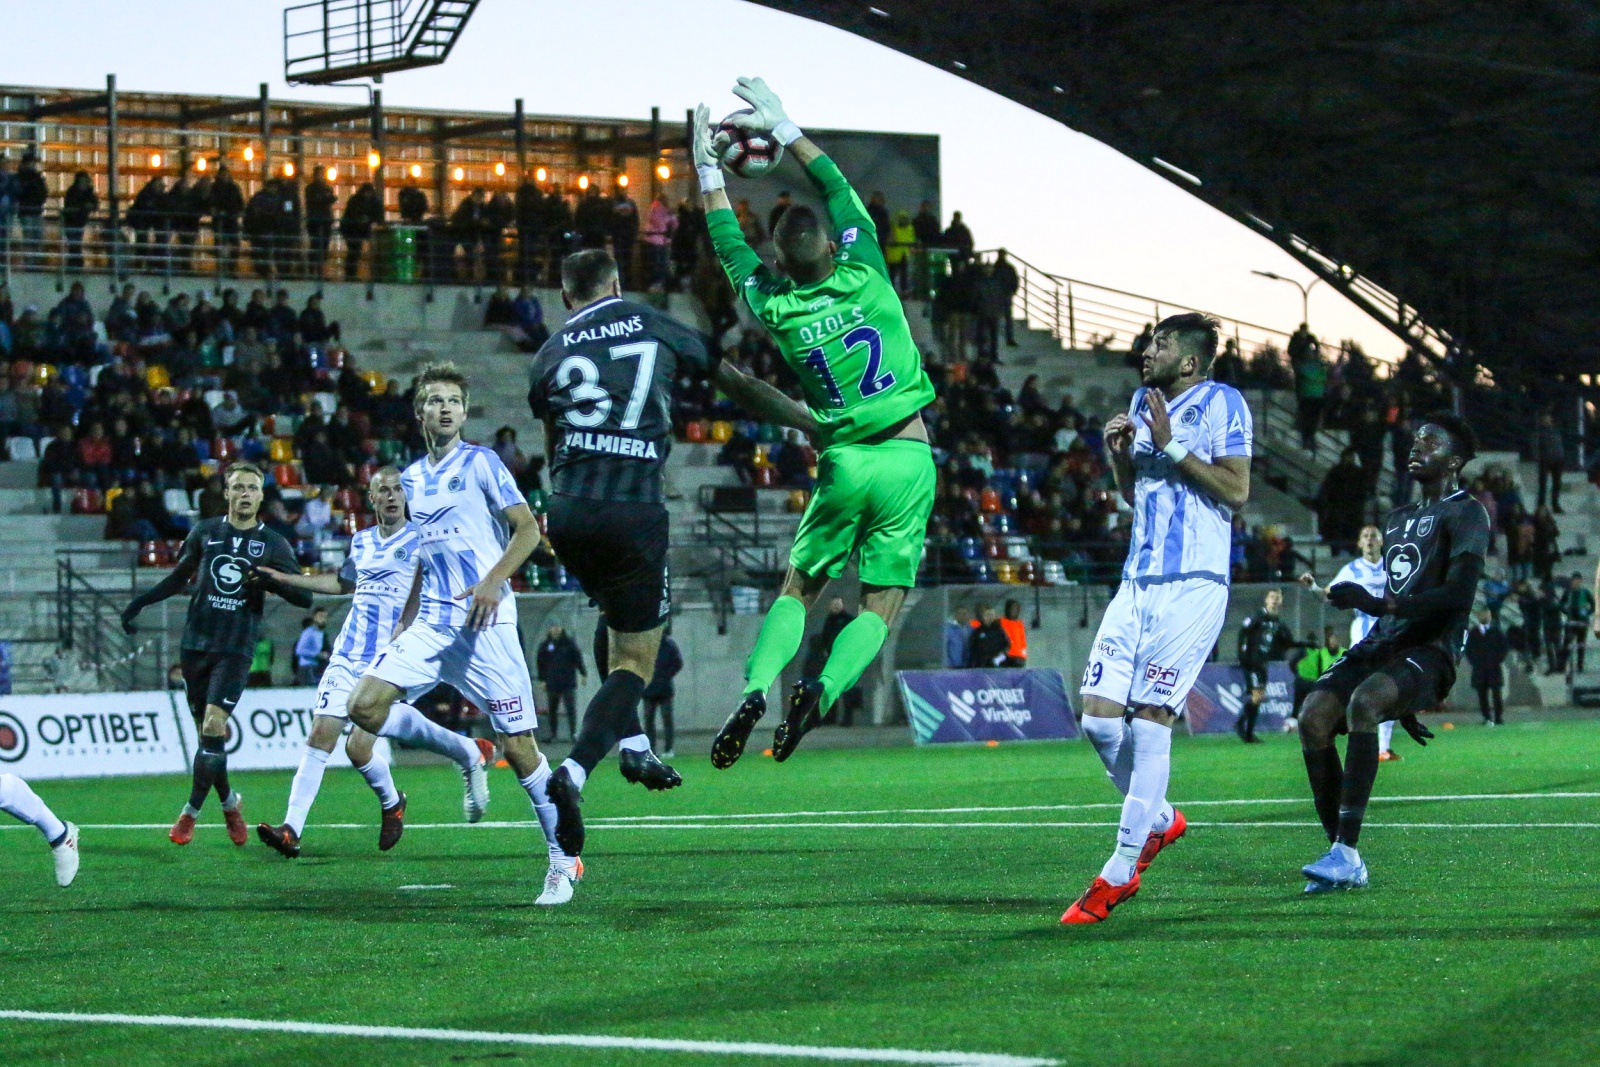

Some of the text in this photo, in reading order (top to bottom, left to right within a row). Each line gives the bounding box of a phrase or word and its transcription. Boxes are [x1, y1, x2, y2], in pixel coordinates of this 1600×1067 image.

[563, 315, 643, 347] KALNIŅŠ
[800, 306, 865, 344] OZOLS
[803, 325, 896, 408] 12
[556, 341, 659, 430] 37
[208, 595, 243, 606] VALMIERA
[212, 602, 236, 611] GLASS
[977, 688, 1025, 704] OPTIBET
[1153, 687, 1172, 697] JAKO
[38, 712, 160, 745] OPTIBET
